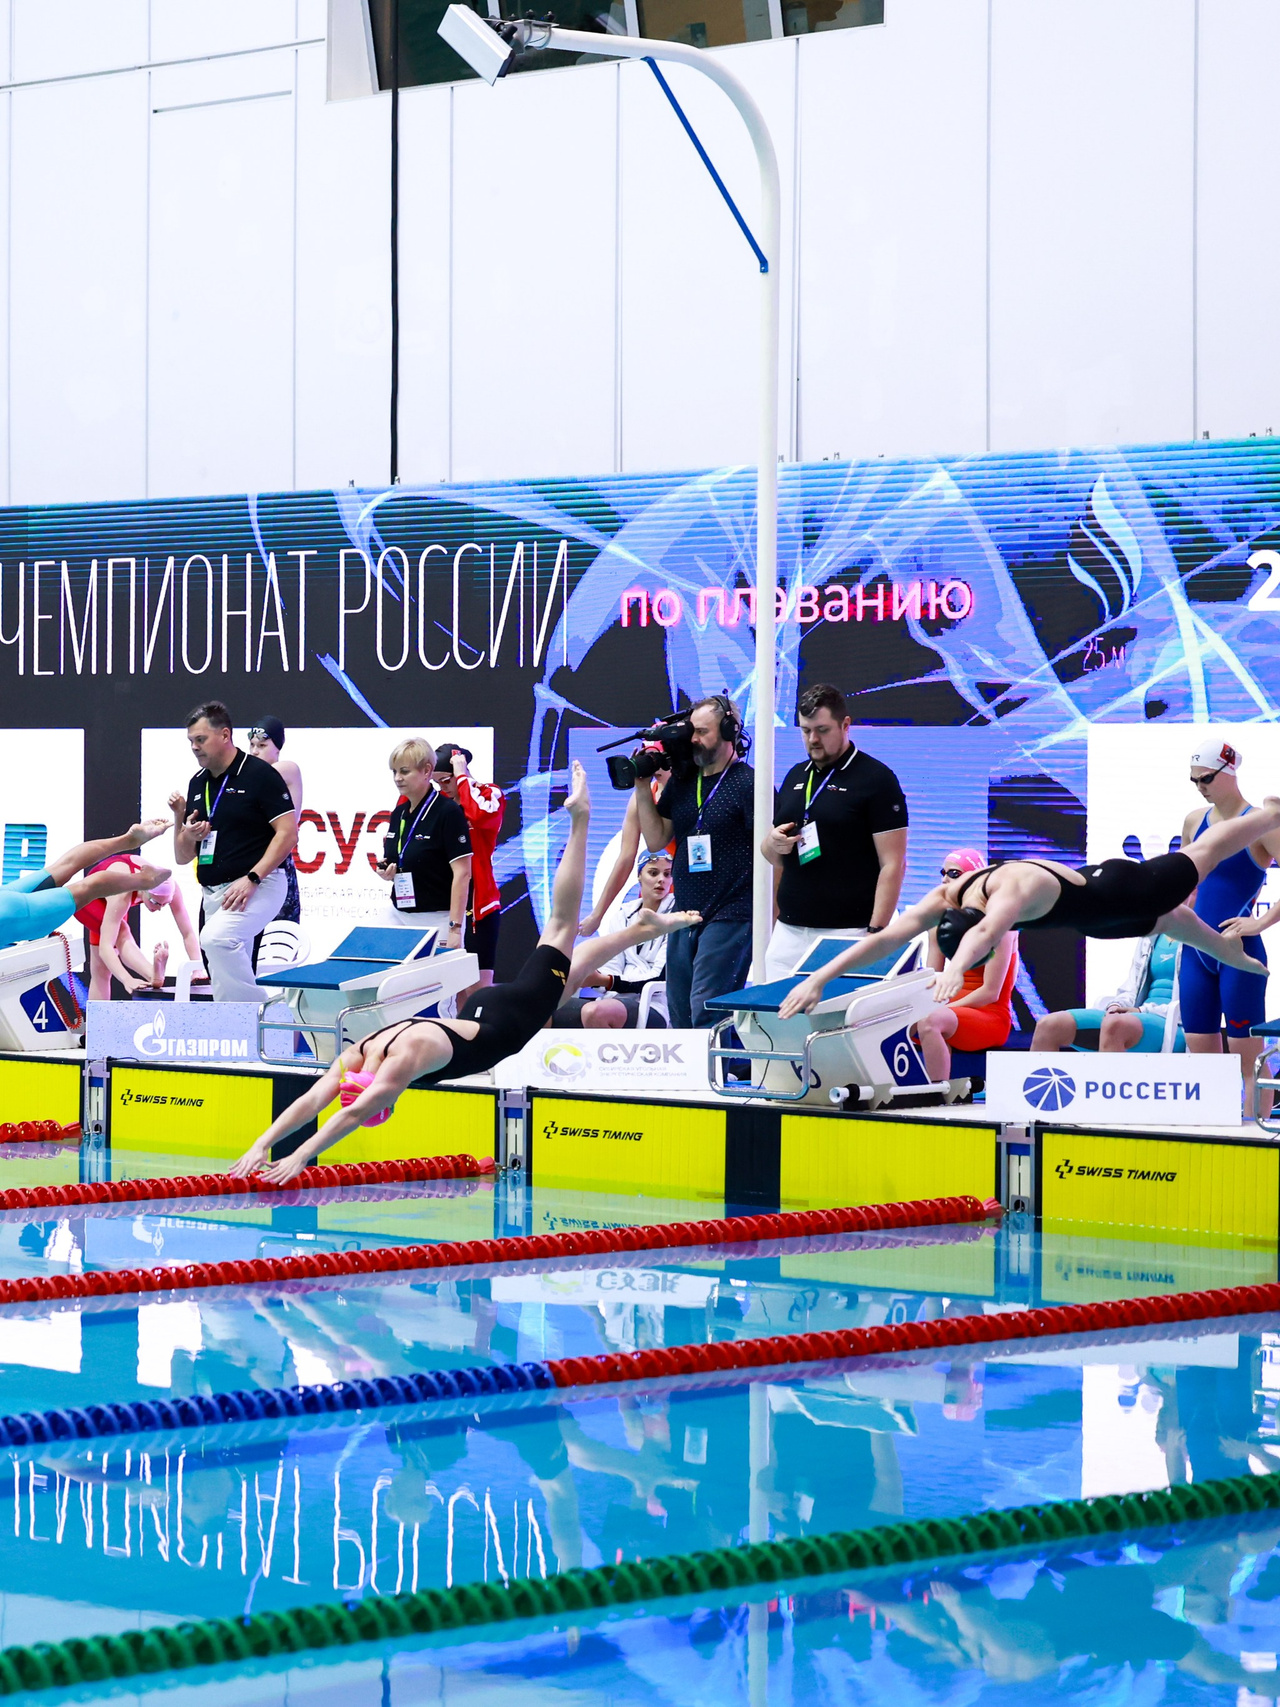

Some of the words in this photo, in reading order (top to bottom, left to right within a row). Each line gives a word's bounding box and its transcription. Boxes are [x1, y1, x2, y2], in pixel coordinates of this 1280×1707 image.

[338, 540, 569, 673] РОССИИ
[620, 587, 680, 627] по
[32, 1000, 49, 1030] 4
[167, 1038, 249, 1057] ГАЗПРОМ
[597, 1042, 685, 1064] СУЭК
[893, 1041, 910, 1078] 6
[134, 1093, 167, 1105] SWISS
[169, 1096, 204, 1108] TIMING
[1084, 1081, 1201, 1101] РОССЕТИ
[559, 1126, 600, 1139] SWISS
[601, 1128, 644, 1142] TIMING
[1075, 1165, 1124, 1180] SWISS
[1126, 1168, 1178, 1183] TIMING
